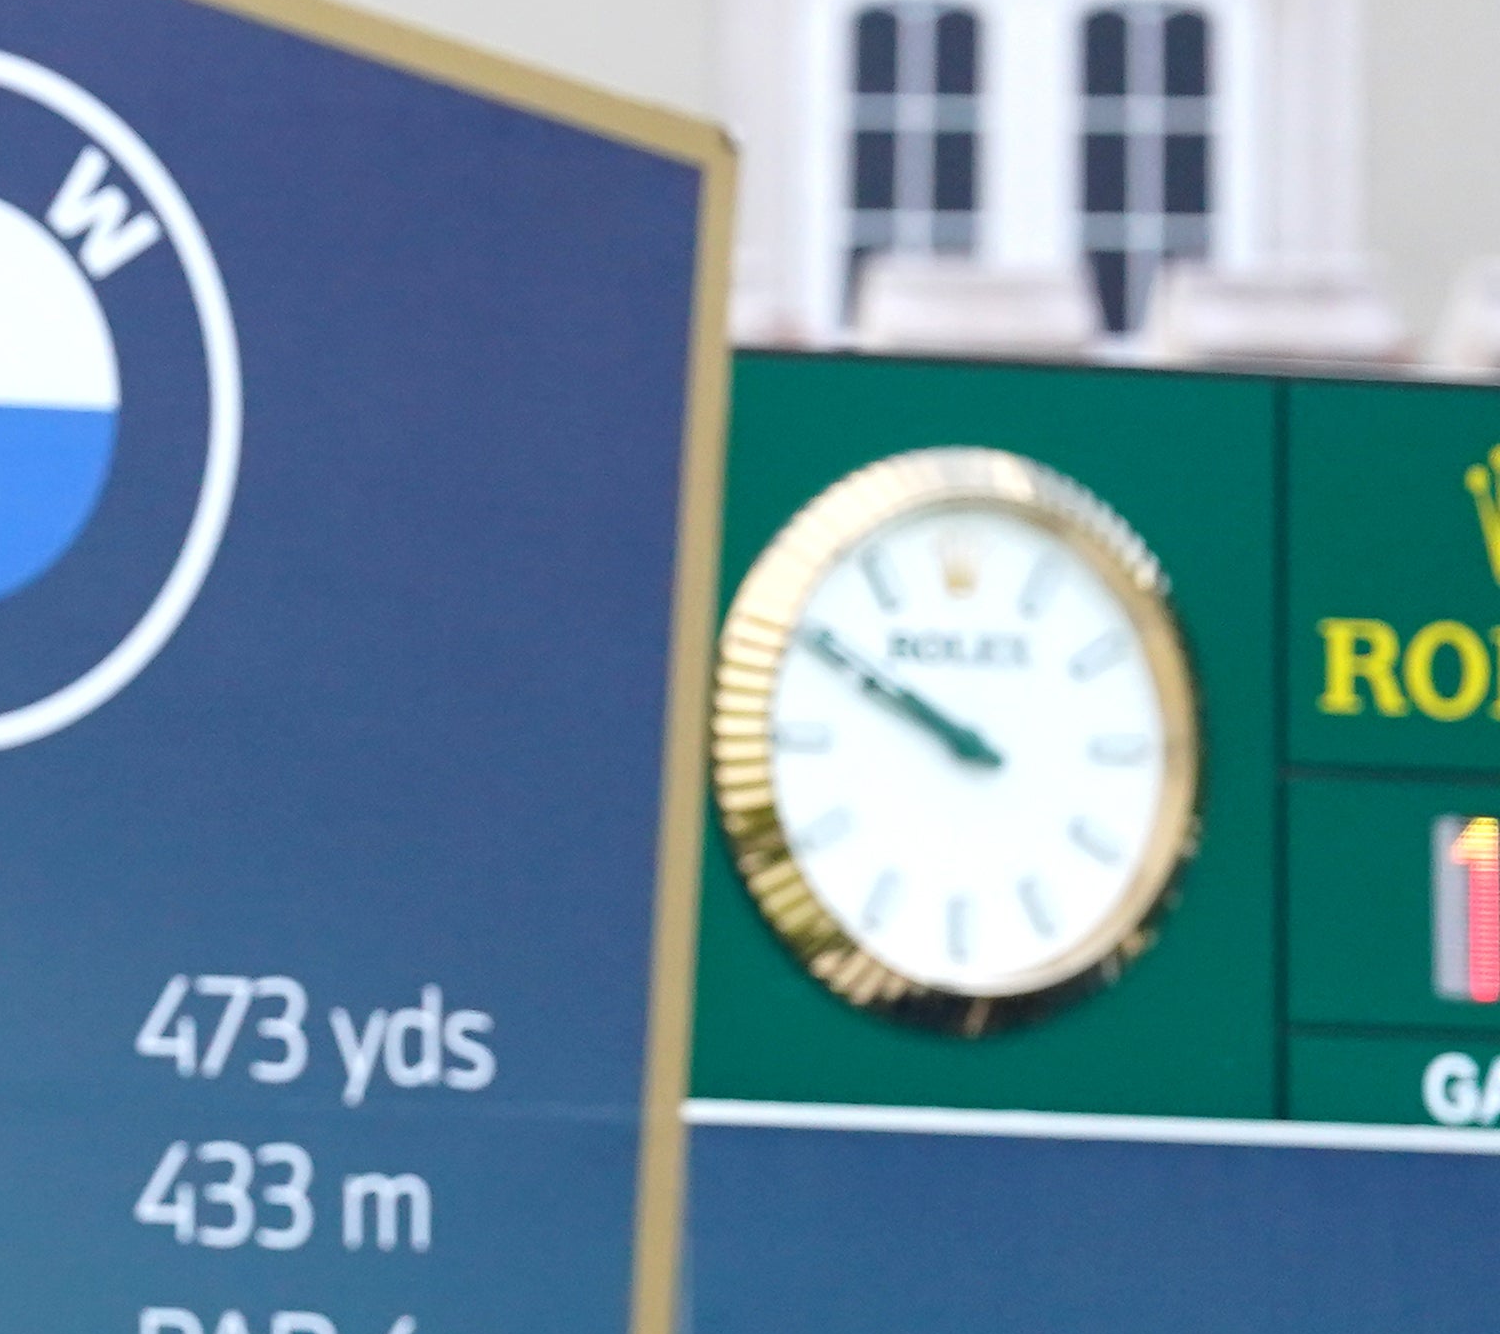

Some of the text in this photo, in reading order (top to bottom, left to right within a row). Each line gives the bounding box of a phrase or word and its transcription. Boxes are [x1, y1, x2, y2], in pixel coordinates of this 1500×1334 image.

[887, 630, 1030, 668] ROLEX
[1315, 617, 1500, 723] RO
[134, 973, 497, 1108] 473 yds
[132, 1139, 432, 1254] 433 m
